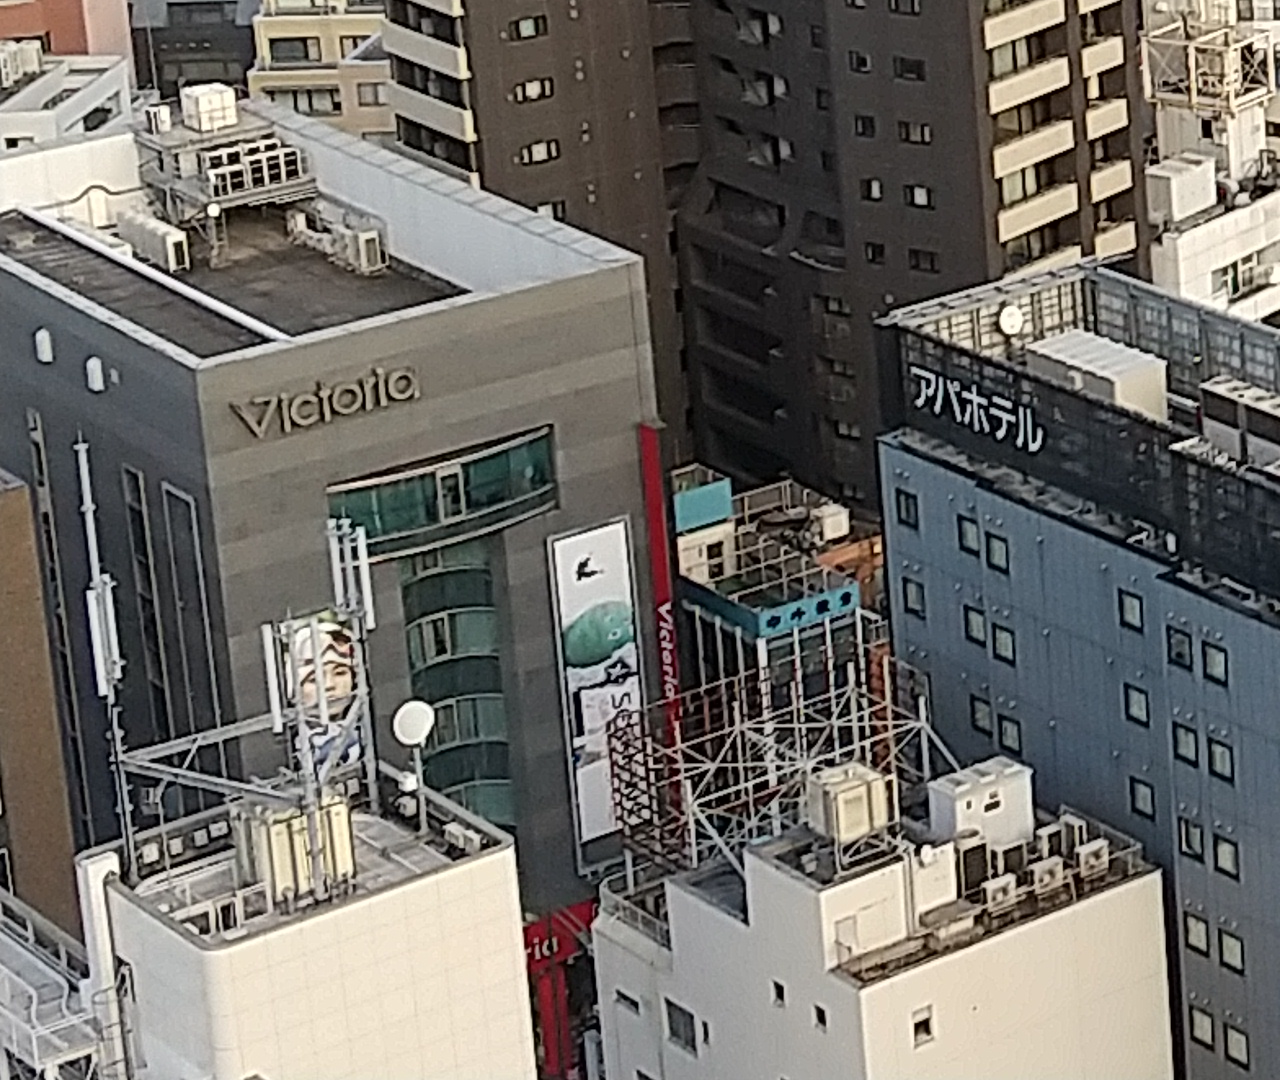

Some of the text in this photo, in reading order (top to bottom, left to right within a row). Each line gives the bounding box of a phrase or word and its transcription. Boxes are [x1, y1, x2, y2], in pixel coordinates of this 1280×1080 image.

[229, 367, 420, 438] Victoria
[910, 366, 1044, 452] アパホテル
[658, 601, 677, 700] Victoria
